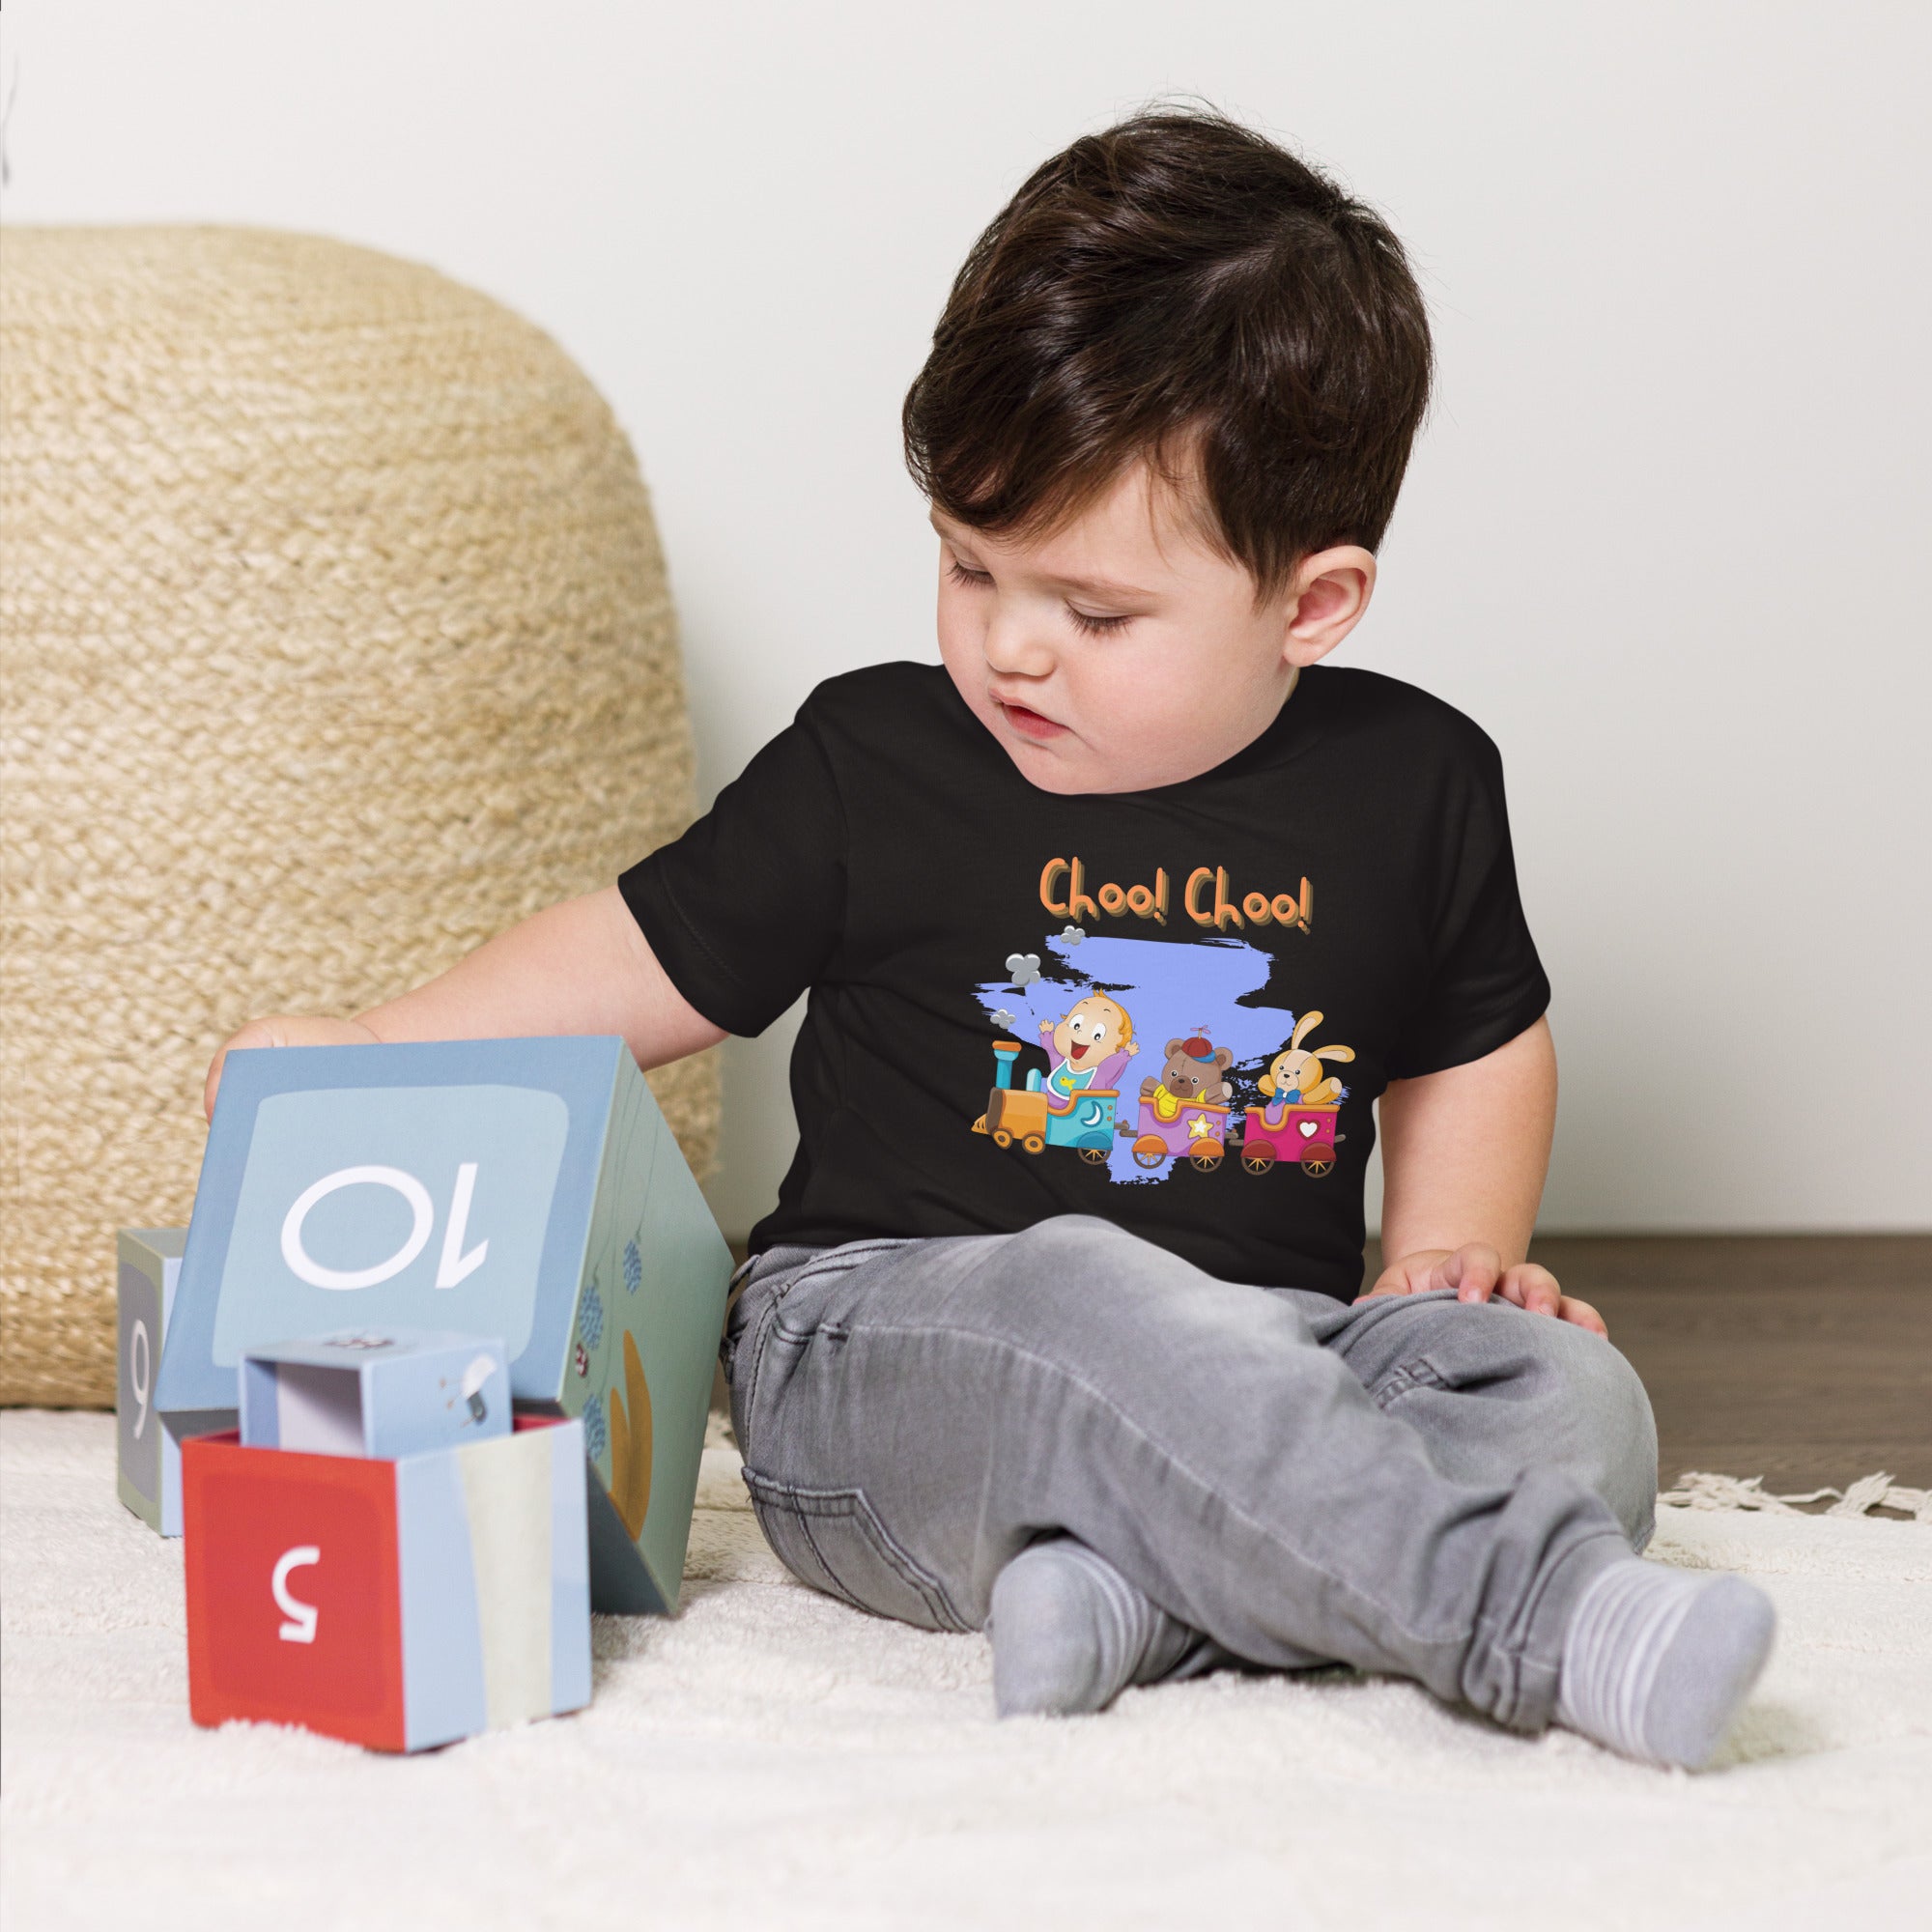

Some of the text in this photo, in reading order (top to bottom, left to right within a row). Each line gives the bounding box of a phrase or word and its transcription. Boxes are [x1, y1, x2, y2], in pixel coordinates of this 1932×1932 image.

[1039, 856, 1314, 934] Choo! Choo!
[280, 1162, 489, 1291] 10
[271, 1546, 321, 1644] 5
